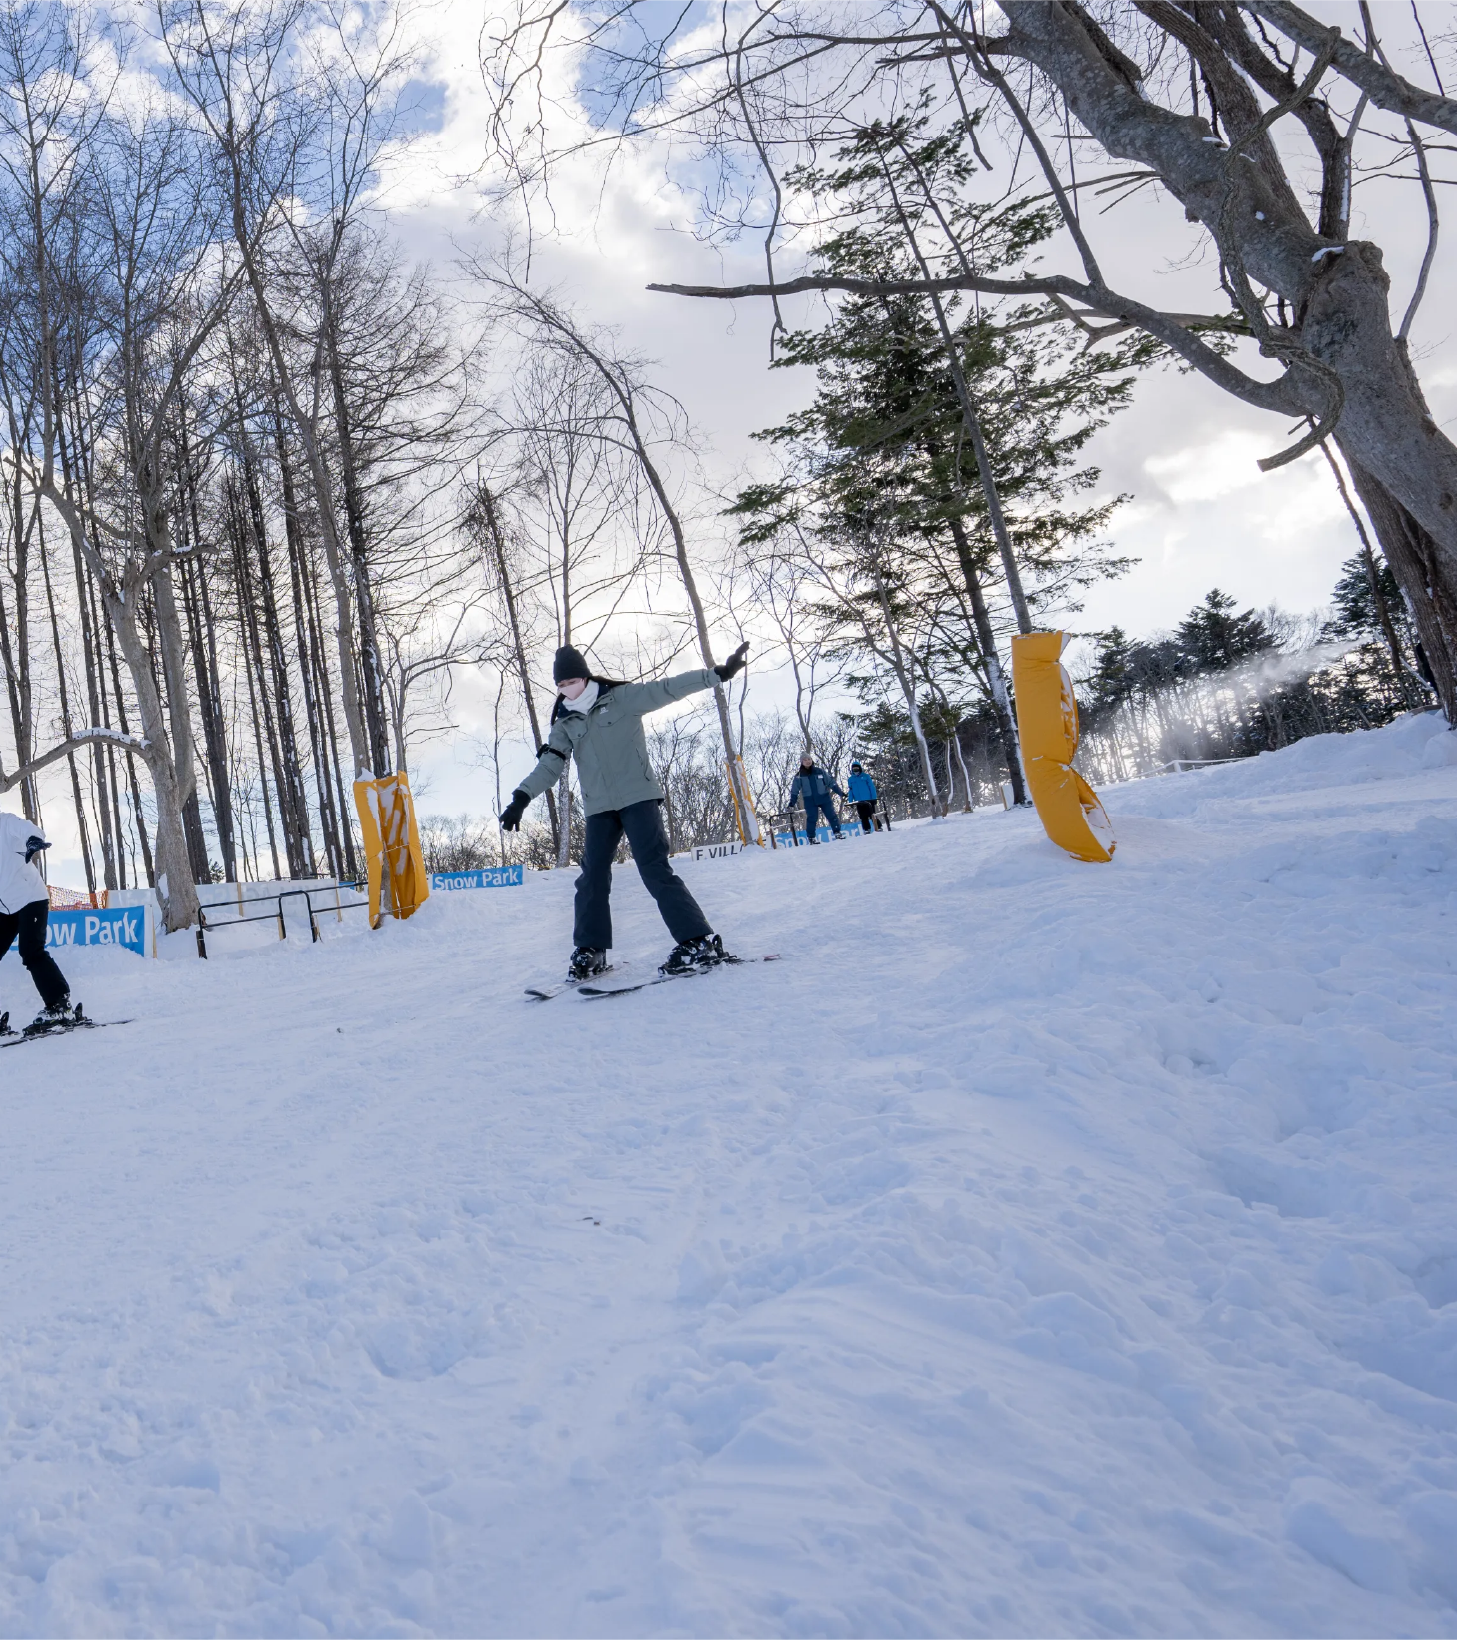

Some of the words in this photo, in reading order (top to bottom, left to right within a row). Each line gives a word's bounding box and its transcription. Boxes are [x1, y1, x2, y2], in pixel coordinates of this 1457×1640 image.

[434, 875, 477, 890] Snow
[482, 868, 519, 886] Park
[84, 912, 138, 944] Park
